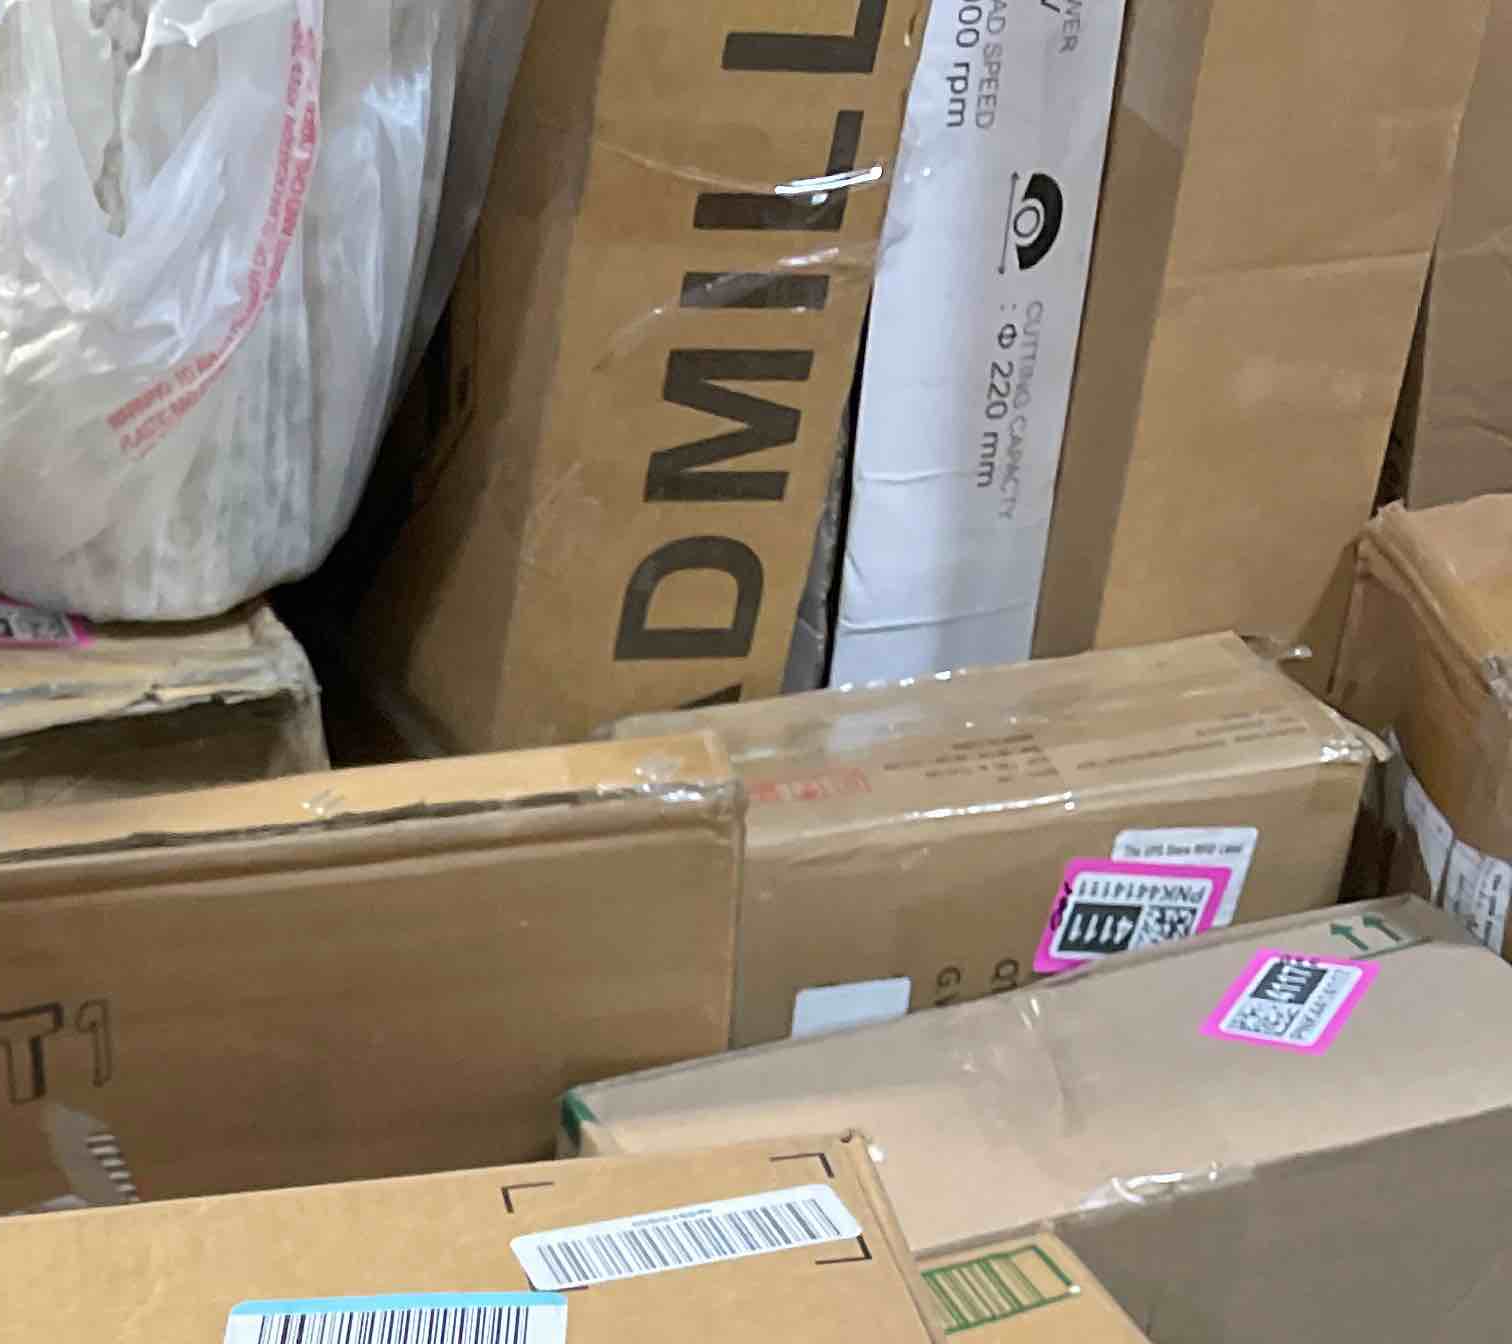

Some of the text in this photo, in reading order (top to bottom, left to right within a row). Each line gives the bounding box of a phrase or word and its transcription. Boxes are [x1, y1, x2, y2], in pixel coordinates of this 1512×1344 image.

[945, 61, 971, 129] rpm
[975, 44, 1003, 130] SPEED
[1020, 300, 1045, 409] CUTTING
[984, 360, 1015, 422] 220
[976, 430, 1000, 490] mm
[1068, 912, 1135, 945] 4111
